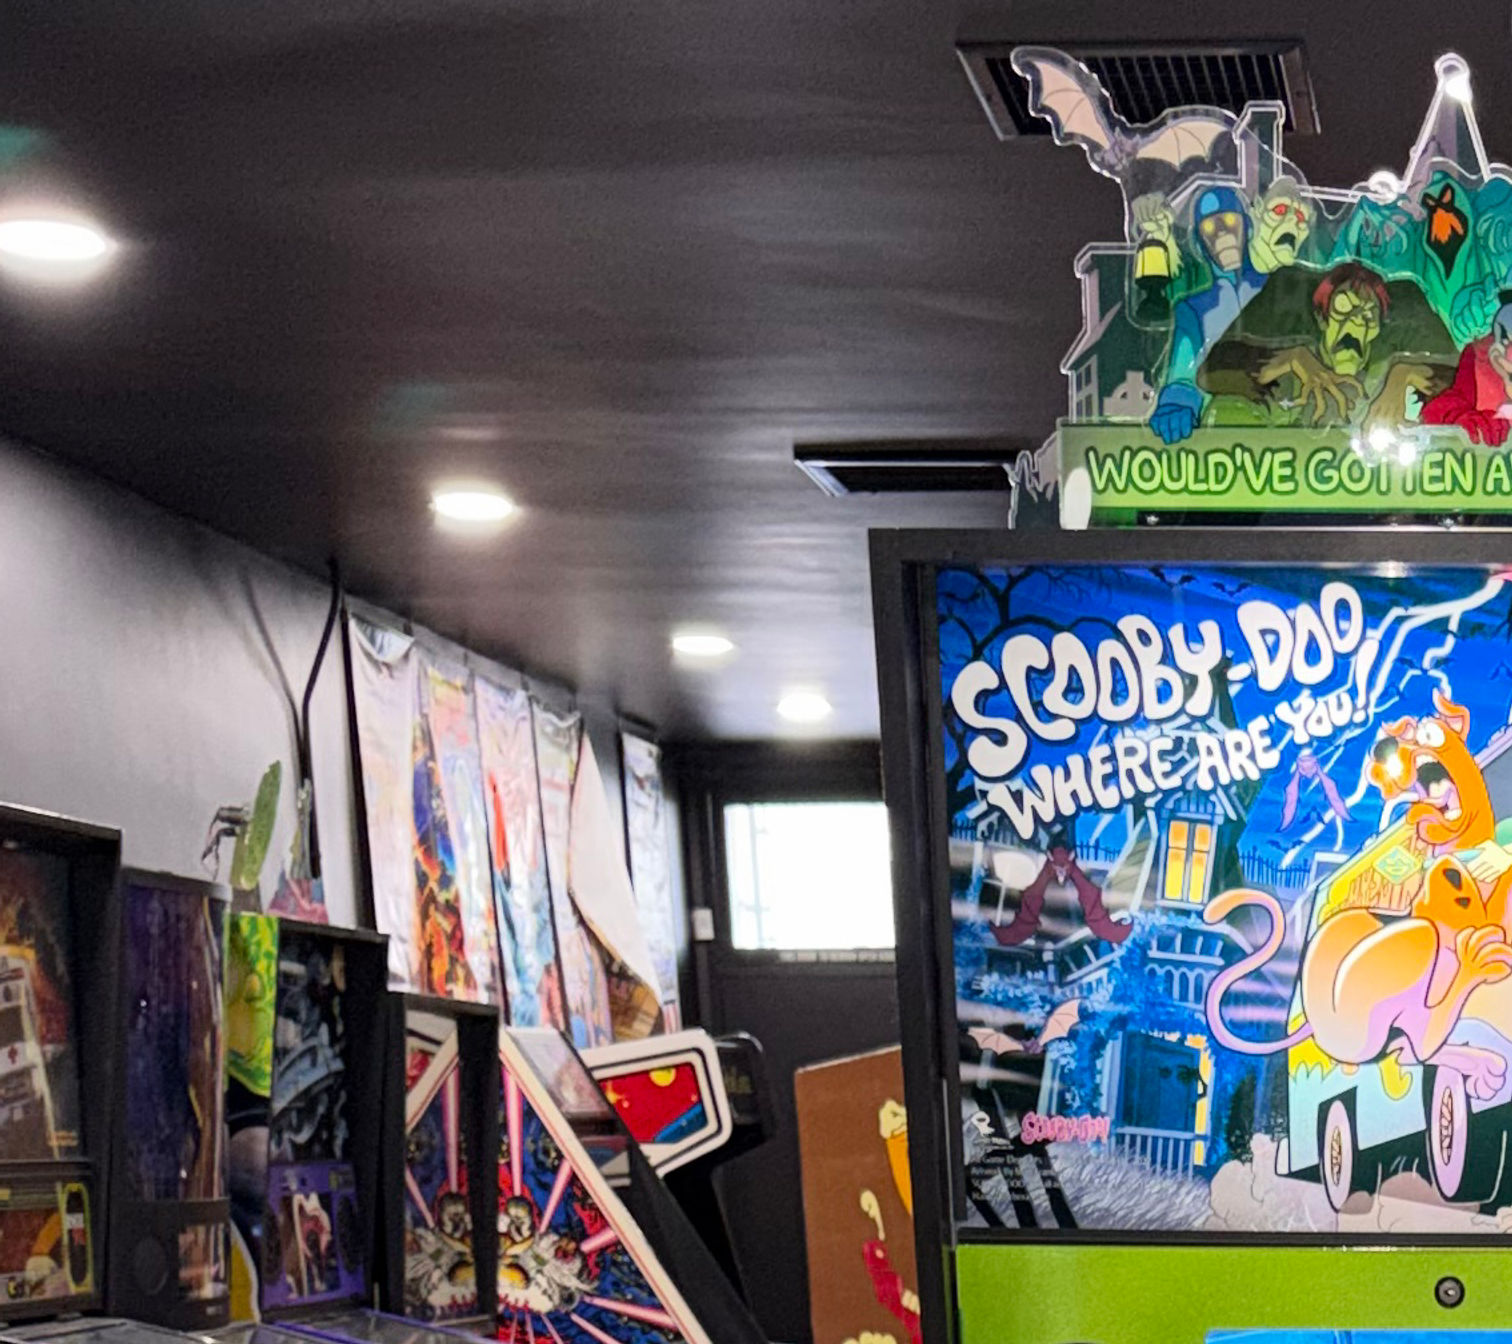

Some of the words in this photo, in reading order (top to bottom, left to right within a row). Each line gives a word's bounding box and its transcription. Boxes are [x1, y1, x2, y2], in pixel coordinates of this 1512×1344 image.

[1086, 445, 1295, 494] WOULD'VE
[986, 732, 1184, 839] WHERE
[1195, 715, 1281, 791] ARE
